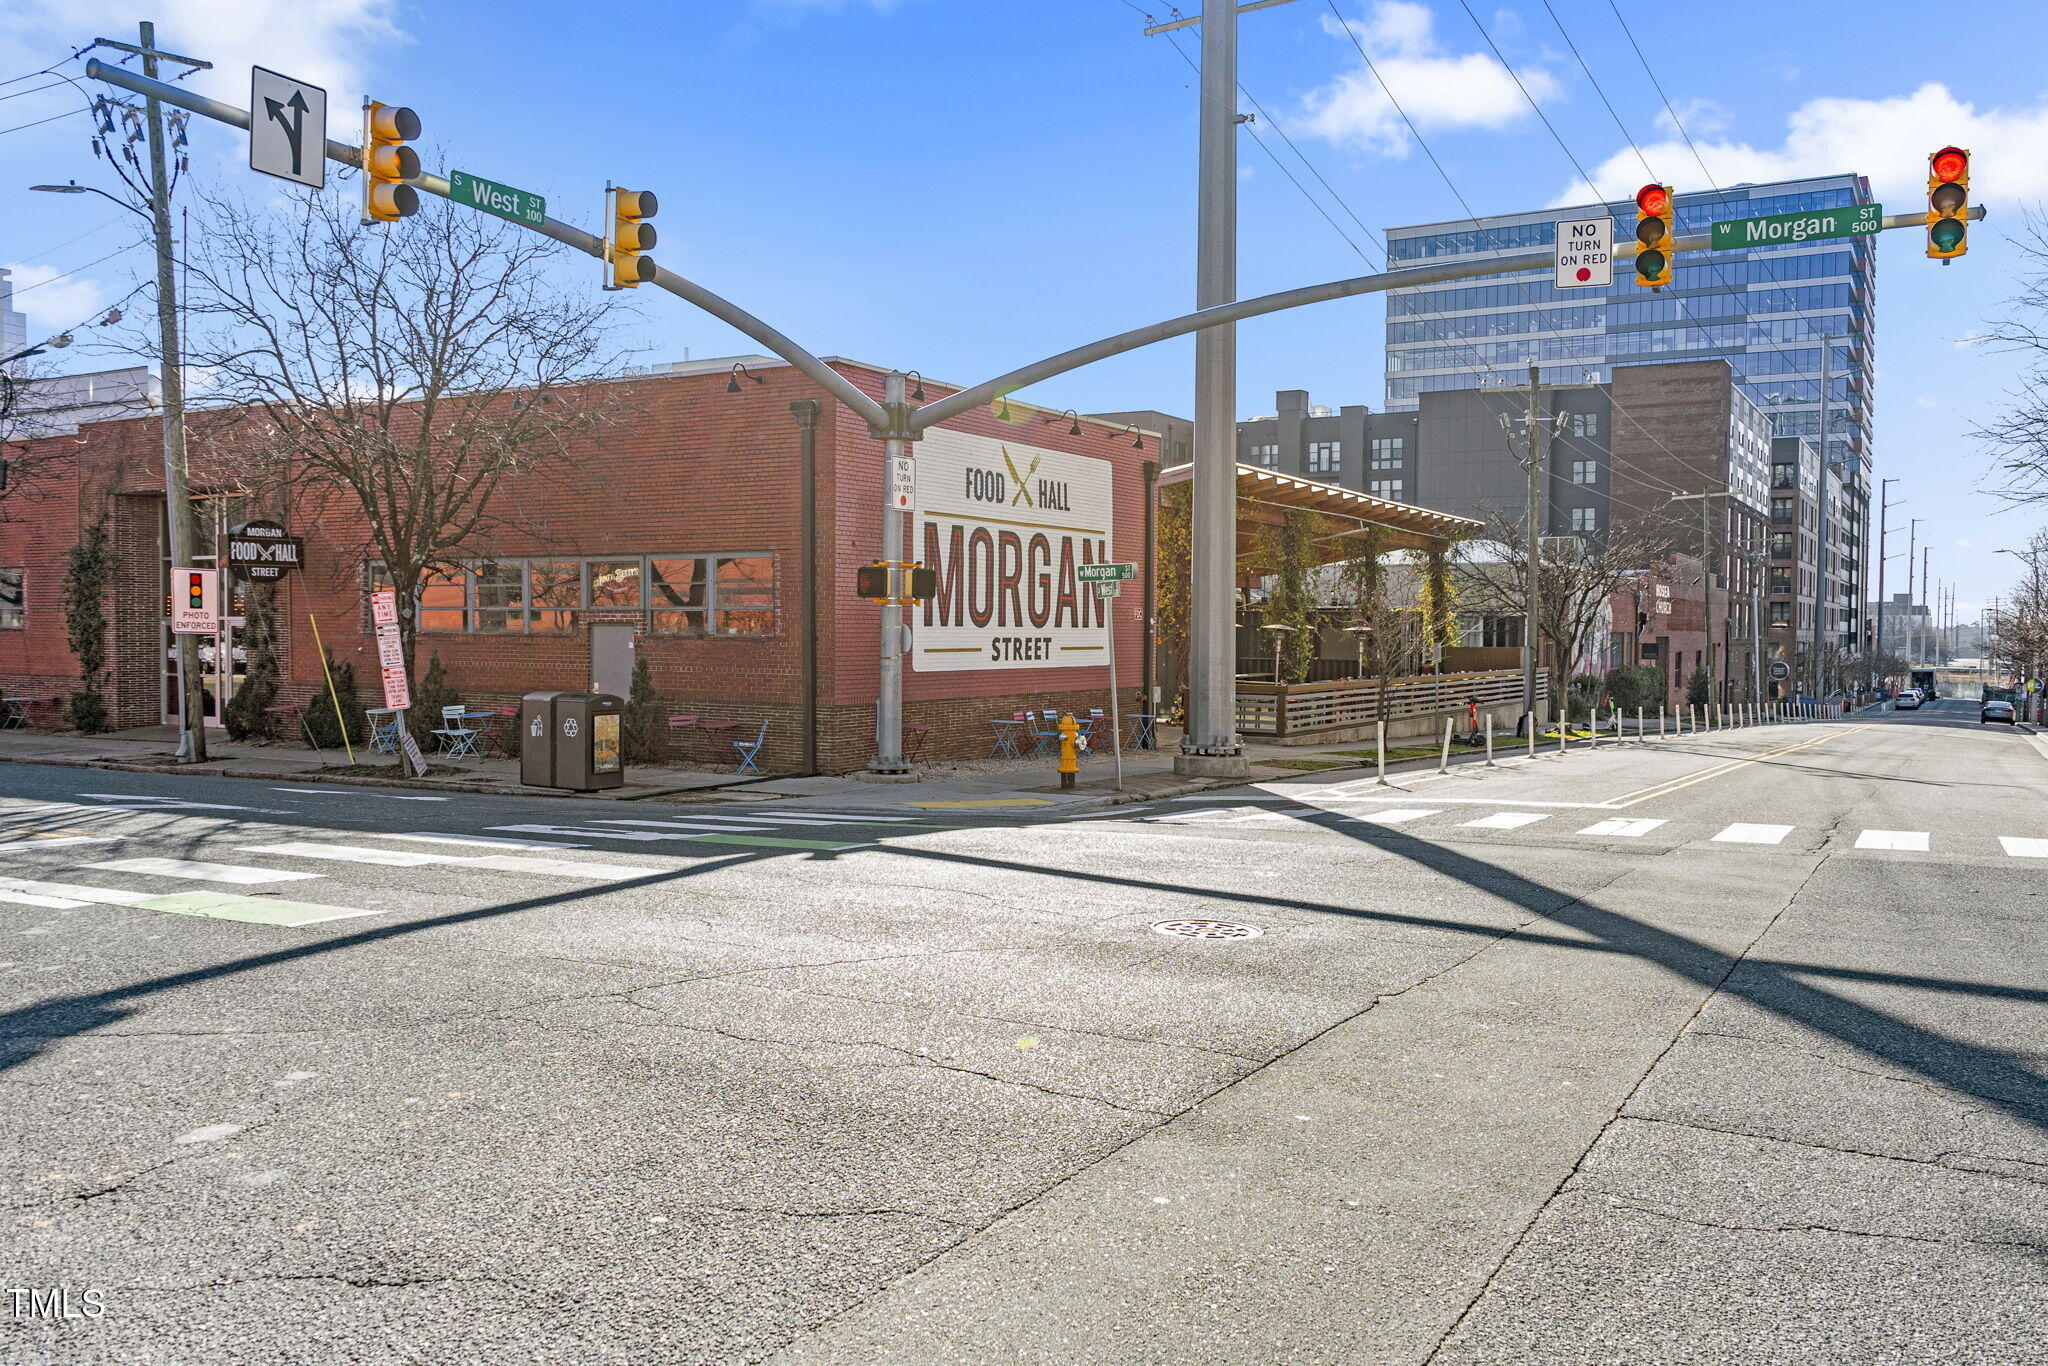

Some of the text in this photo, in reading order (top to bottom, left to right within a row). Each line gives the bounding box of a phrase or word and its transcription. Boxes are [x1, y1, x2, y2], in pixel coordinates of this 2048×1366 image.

[454, 174, 542, 215] S West ST
[526, 208, 542, 223] 100
[1572, 224, 1596, 238] NO
[1719, 207, 1876, 242] W Morgan ST
[1851, 220, 1877, 233] 500
[1567, 239, 1601, 252] TURN
[1560, 253, 1607, 266] ON RED
[898, 460, 909, 471] NO
[896, 472, 911, 482] TURN
[893, 483, 914, 494] ON RED
[965, 467, 1071, 512] FOOD HALL
[246, 527, 282, 538] MORGAN
[230, 541, 298, 562] FOOD HALL
[251, 567, 280, 577] STREET
[923, 521, 1106, 629] MORGAN
[1084, 566, 1116, 580] Morgan
[183, 611, 210, 619] PHOTO
[176, 621, 217, 630] ENFORCED
[991, 636, 1052, 662] STREET
